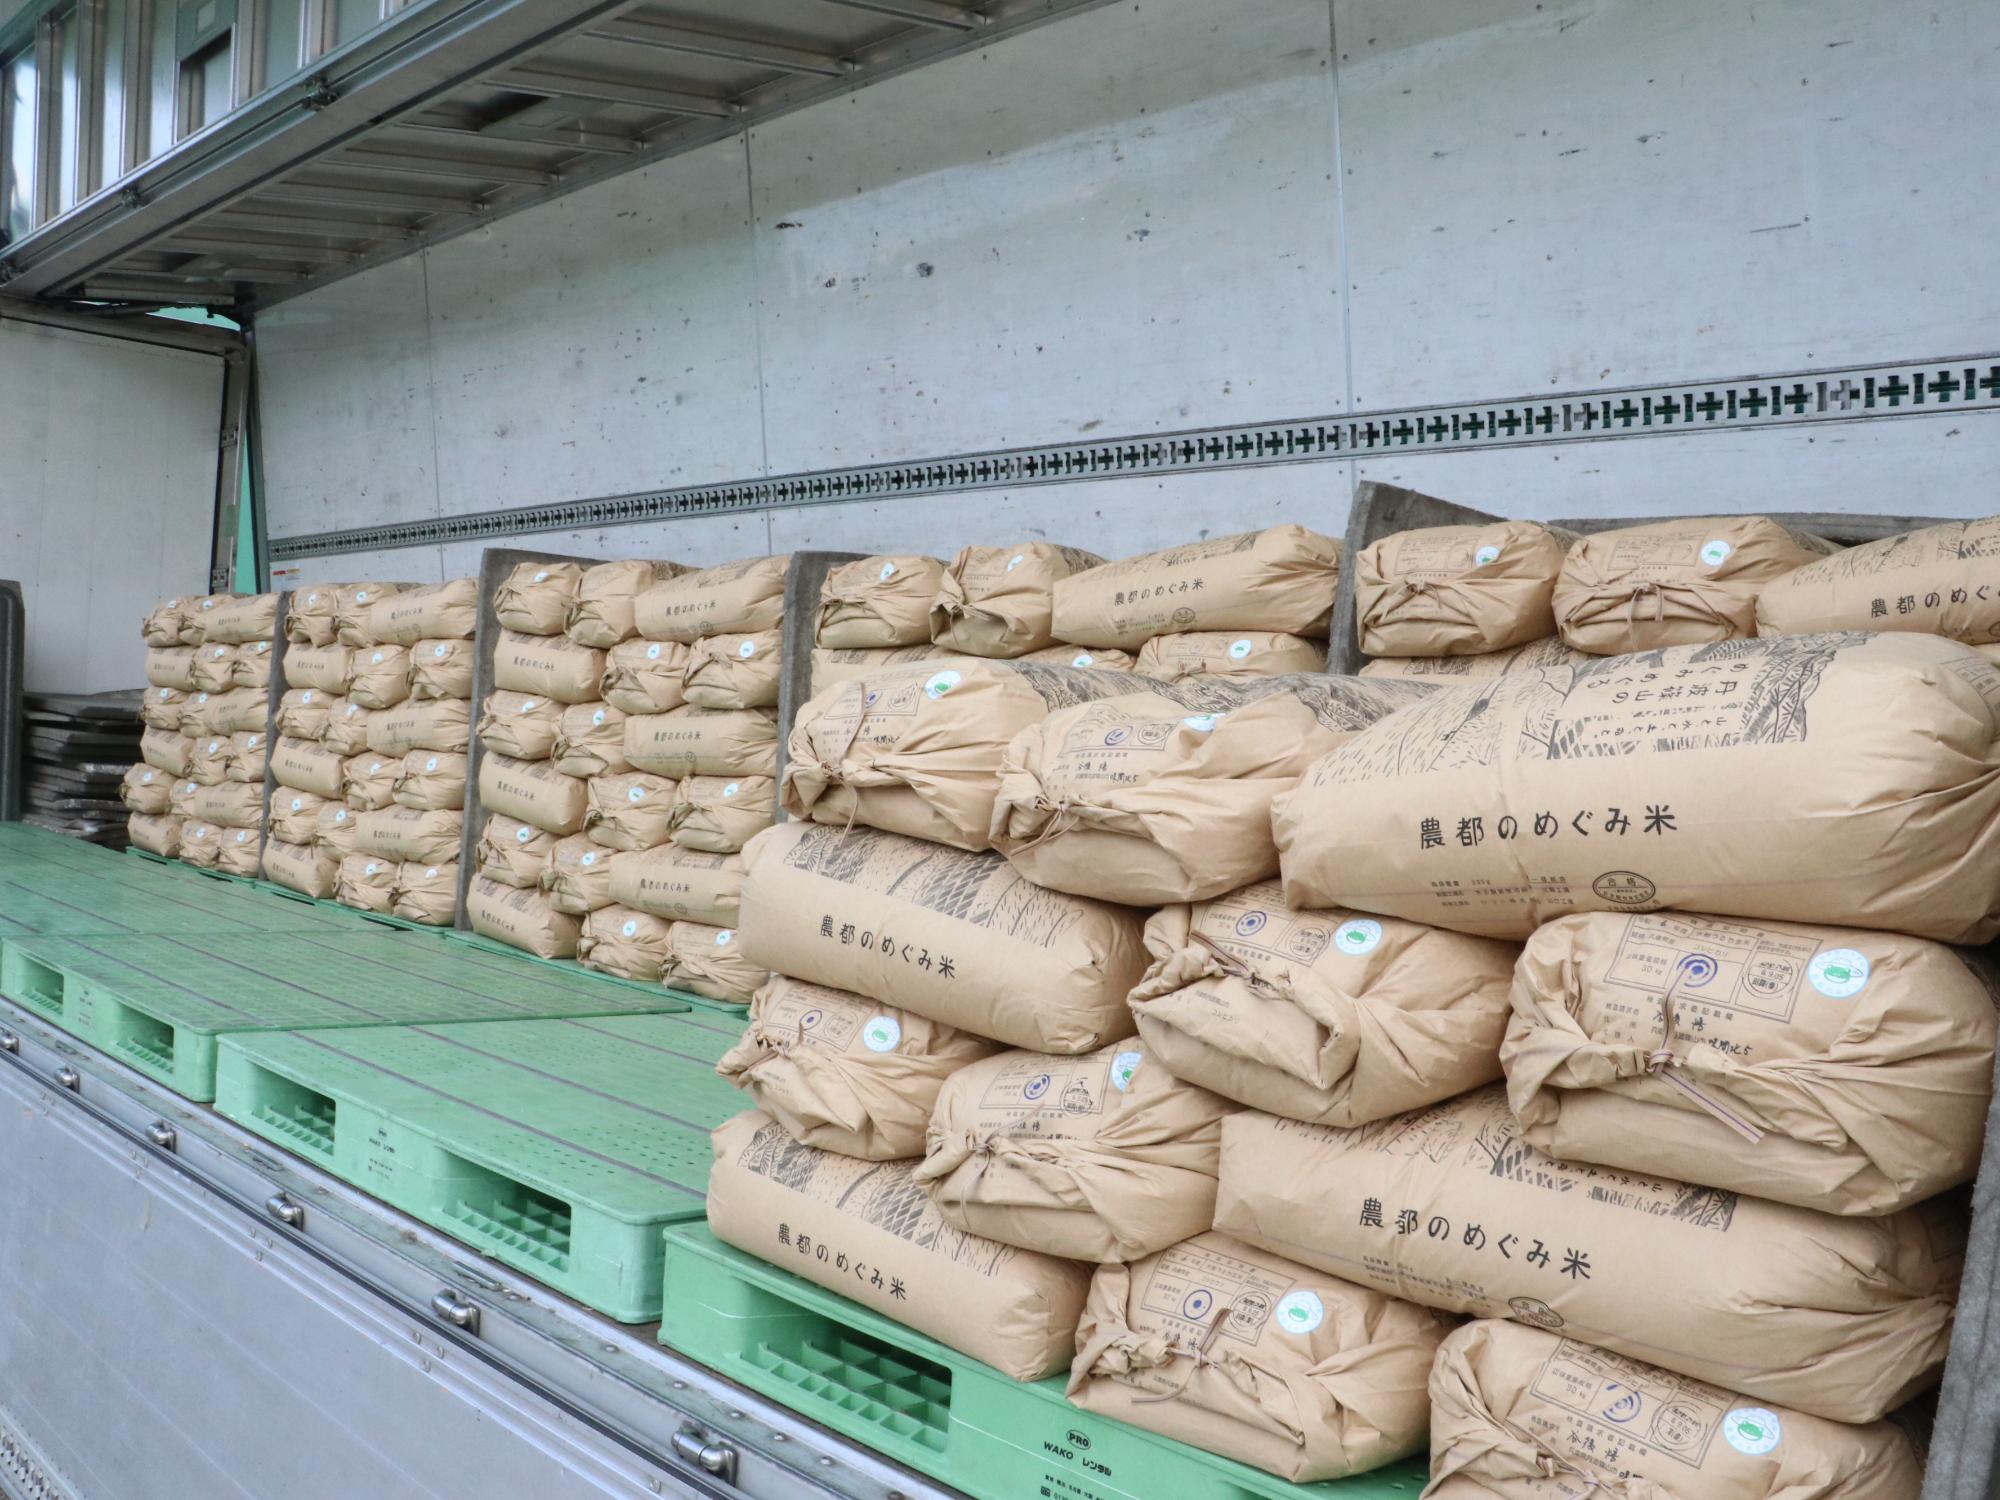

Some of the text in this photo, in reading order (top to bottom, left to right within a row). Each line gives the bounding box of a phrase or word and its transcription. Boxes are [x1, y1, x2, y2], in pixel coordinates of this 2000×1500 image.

[1871, 585, 2000, 618] 農都のめぐ
[1420, 804, 1678, 850] 農都のめぐみ米
[820, 914, 956, 979] 農都のめぐみ米
[778, 1222, 907, 1301] 農都のめぐみ米
[1359, 1197, 1592, 1281] 農都のめぐみ米
[1043, 1440, 1112, 1477] WAKO レンタル
[1068, 1432, 1090, 1447] PRO
